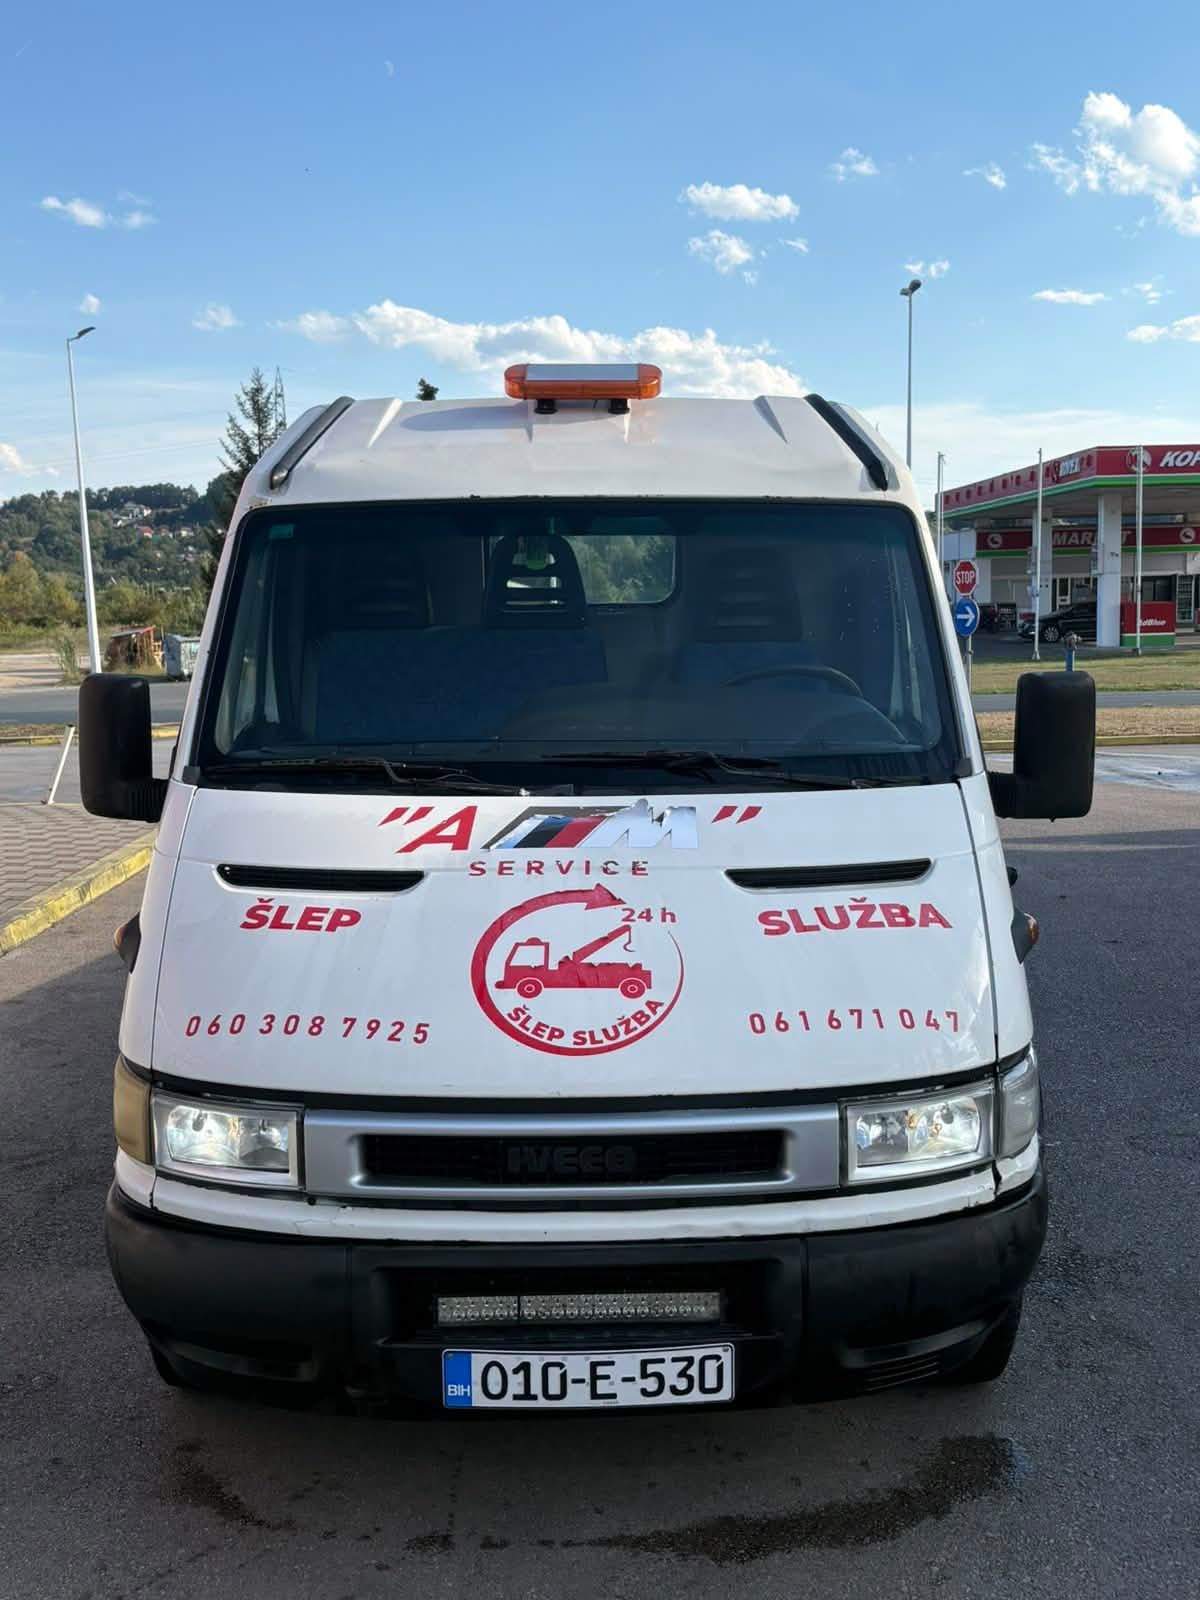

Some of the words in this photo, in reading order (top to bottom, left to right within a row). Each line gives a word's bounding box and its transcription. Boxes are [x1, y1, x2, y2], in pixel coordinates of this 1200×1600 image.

[1053, 529, 1134, 545] MART
[956, 570, 975, 585] STOP
[468, 860, 649, 877] SERVICE
[240, 897, 362, 933] ŠLEP
[757, 896, 953, 936] SLUŽBA
[621, 907, 653, 923] 24
[660, 907, 677, 923] h
[184, 1014, 246, 1037] 060
[259, 1013, 326, 1037] 308
[342, 1016, 430, 1044] 7925
[507, 1003, 565, 1045] ŠLEP
[572, 998, 664, 1046] SLUŽBA
[749, 1010, 811, 1034] 061
[827, 1008, 885, 1031] 671
[899, 1008, 960, 1033] 047
[507, 1145, 636, 1172] IVECO
[447, 1383, 471, 1397] BIH
[480, 1353, 725, 1402] 010-E-530
